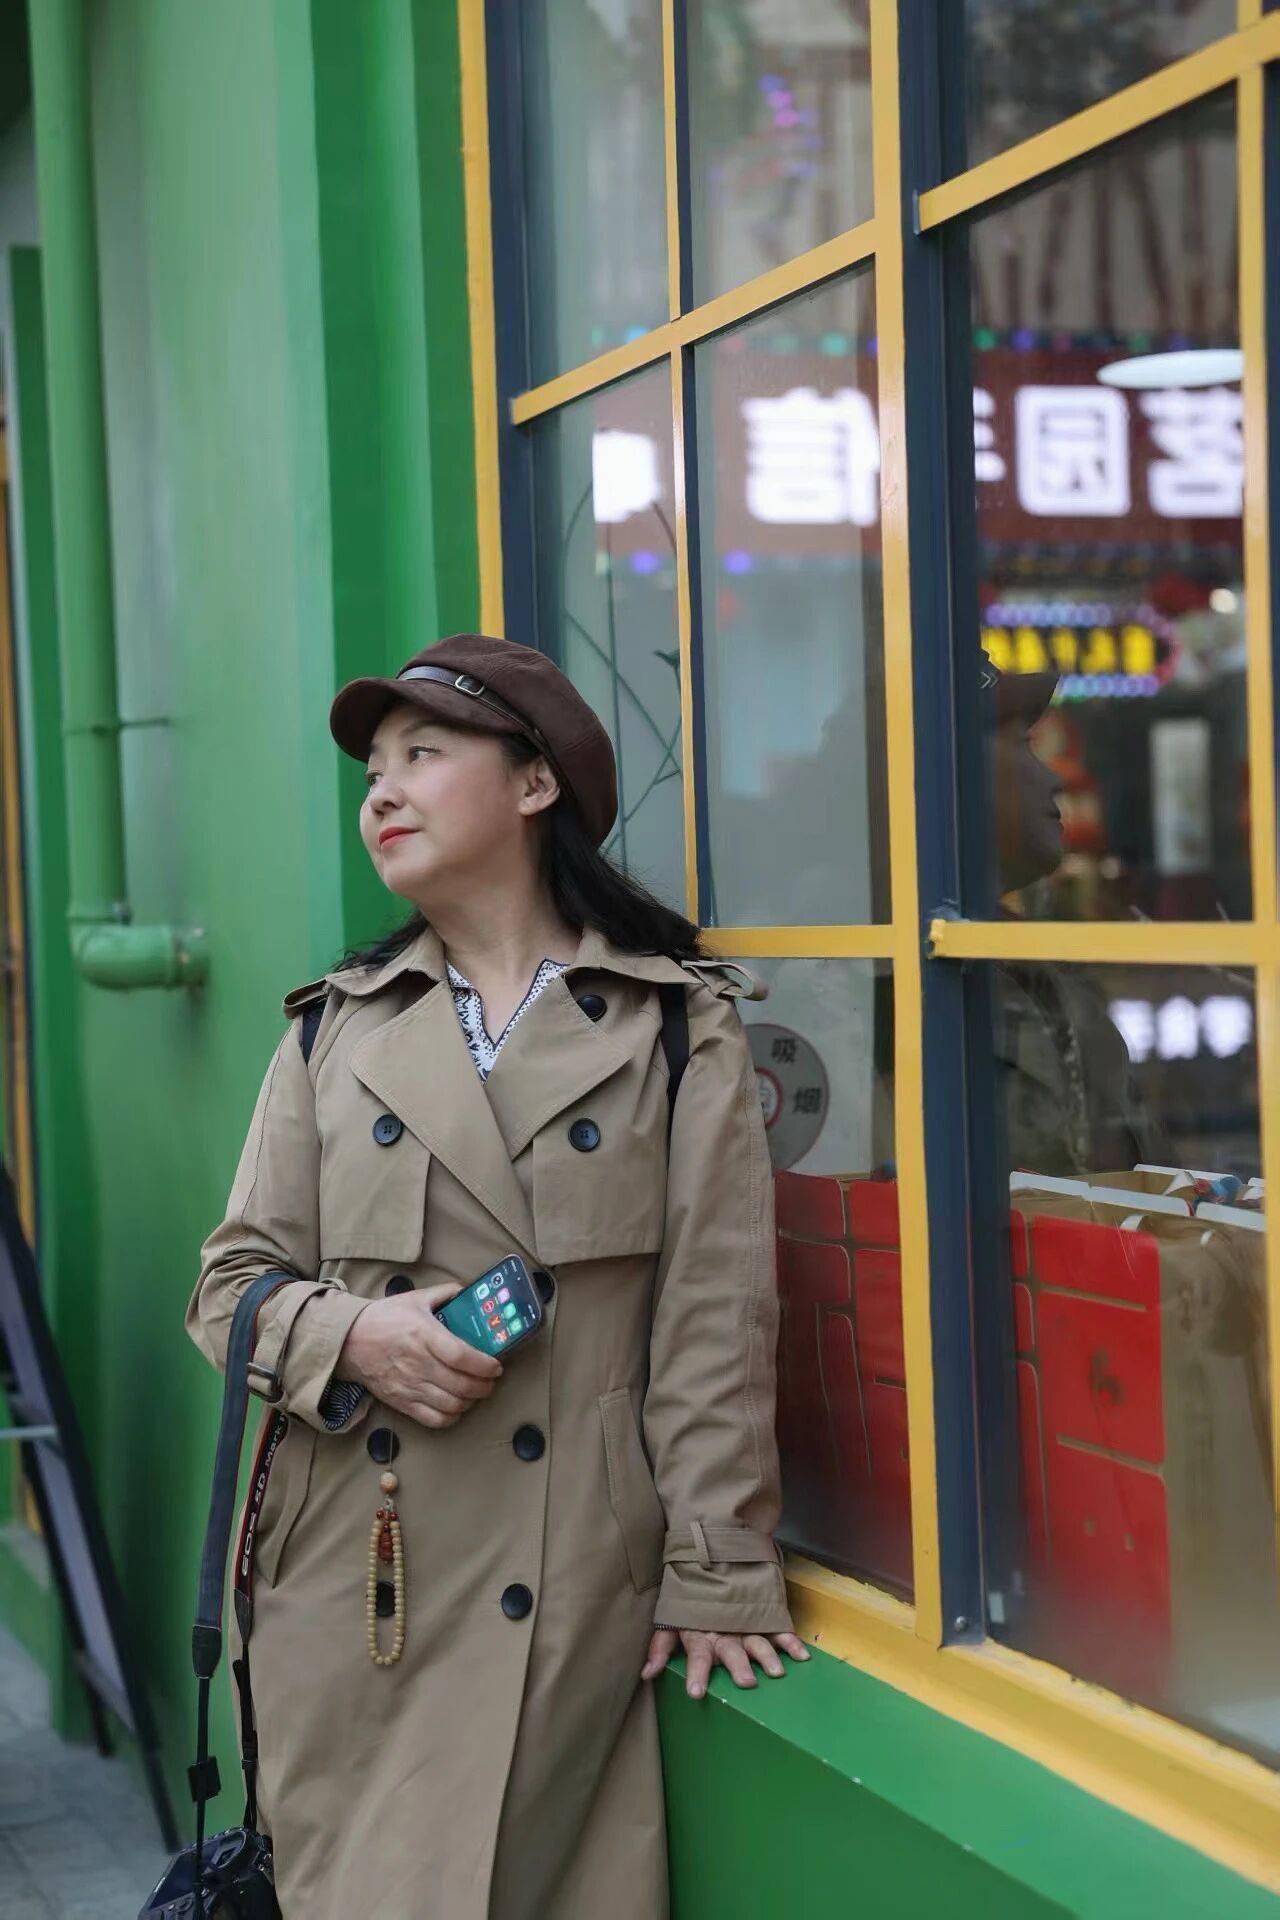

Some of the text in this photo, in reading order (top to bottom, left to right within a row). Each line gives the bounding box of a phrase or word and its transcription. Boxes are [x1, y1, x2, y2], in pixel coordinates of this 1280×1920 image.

[242, 1512, 256, 1577] EOS
[255, 1473, 266, 1503] 5D
[265, 1425, 282, 1467] Mark
